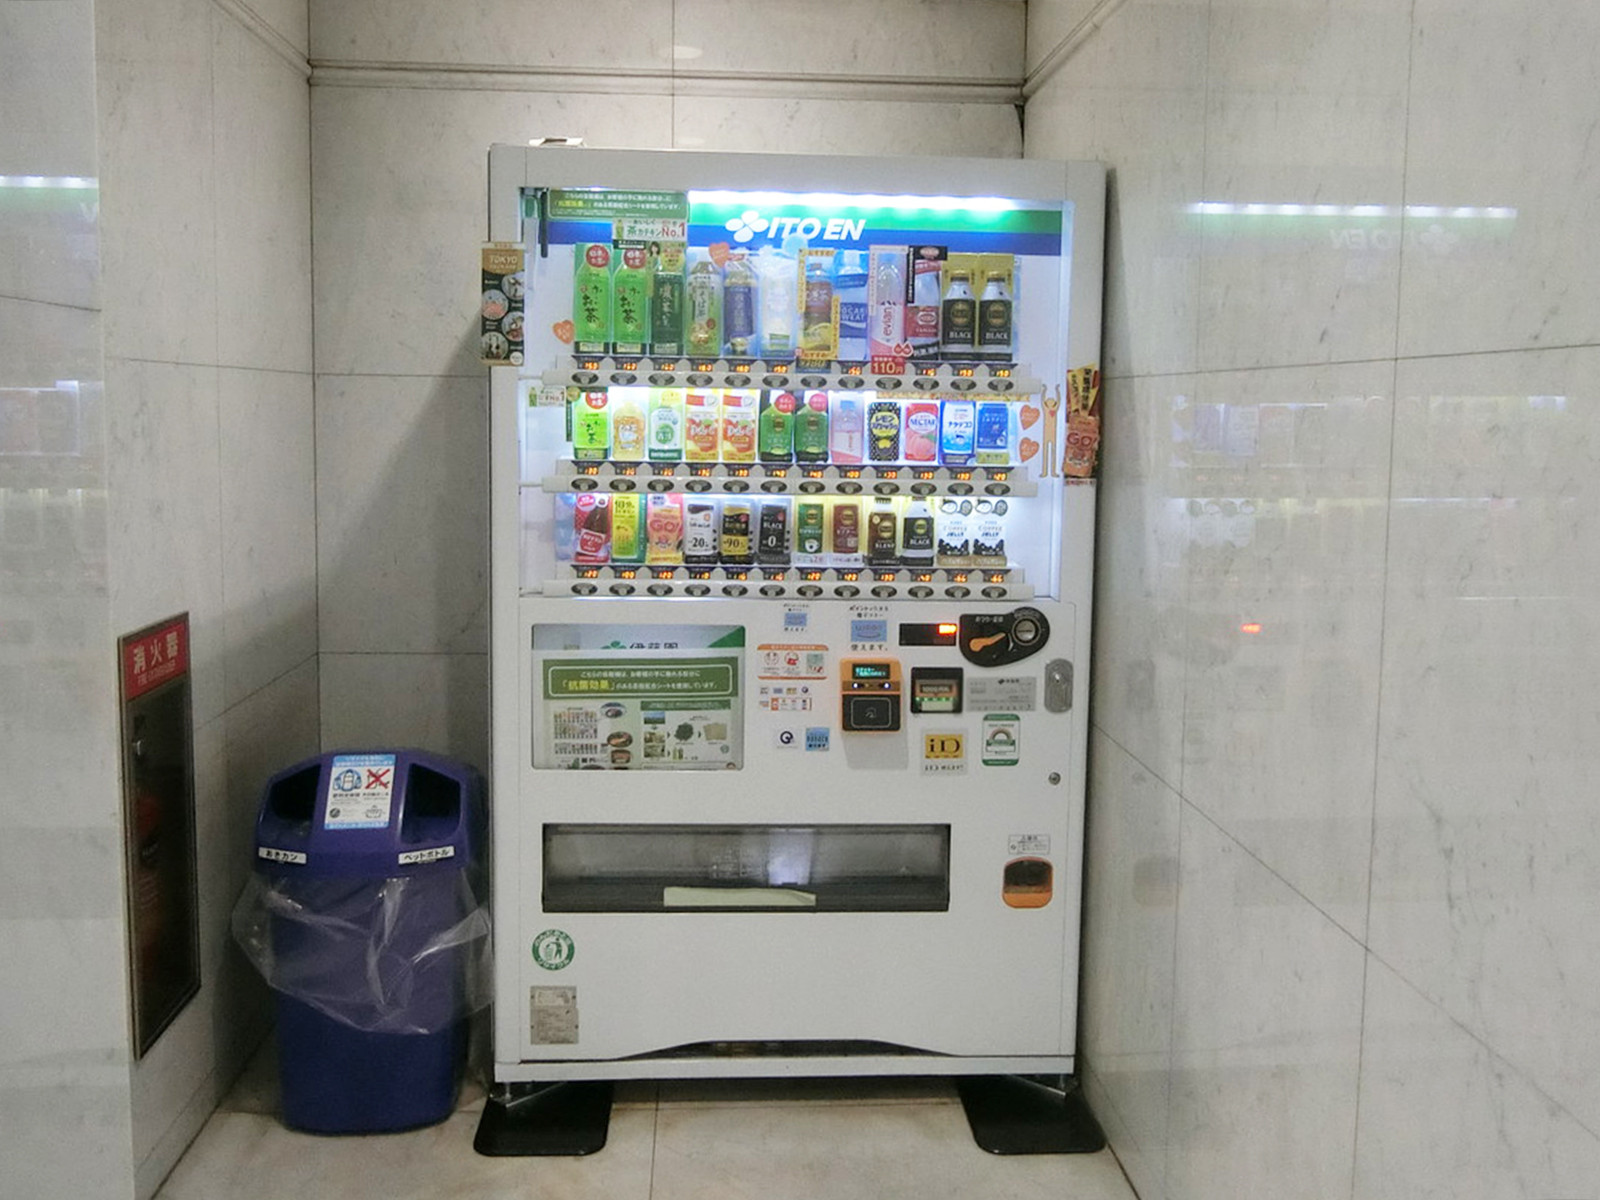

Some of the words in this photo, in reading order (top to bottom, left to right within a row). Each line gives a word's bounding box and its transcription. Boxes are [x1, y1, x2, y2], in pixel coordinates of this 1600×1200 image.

[768, 217, 821, 241] ITO
[823, 217, 866, 241] EN
[489, 254, 519, 264] TOKYO
[882, 305, 893, 337] evian
[949, 330, 972, 339] BLACK
[985, 331, 1009, 340] BLACK
[873, 363, 903, 374] 110円
[948, 420, 973, 429] ナタデココ
[692, 537, 705, 548] 20
[929, 738, 960, 753] iD
[403, 848, 450, 861] ペットボトル
